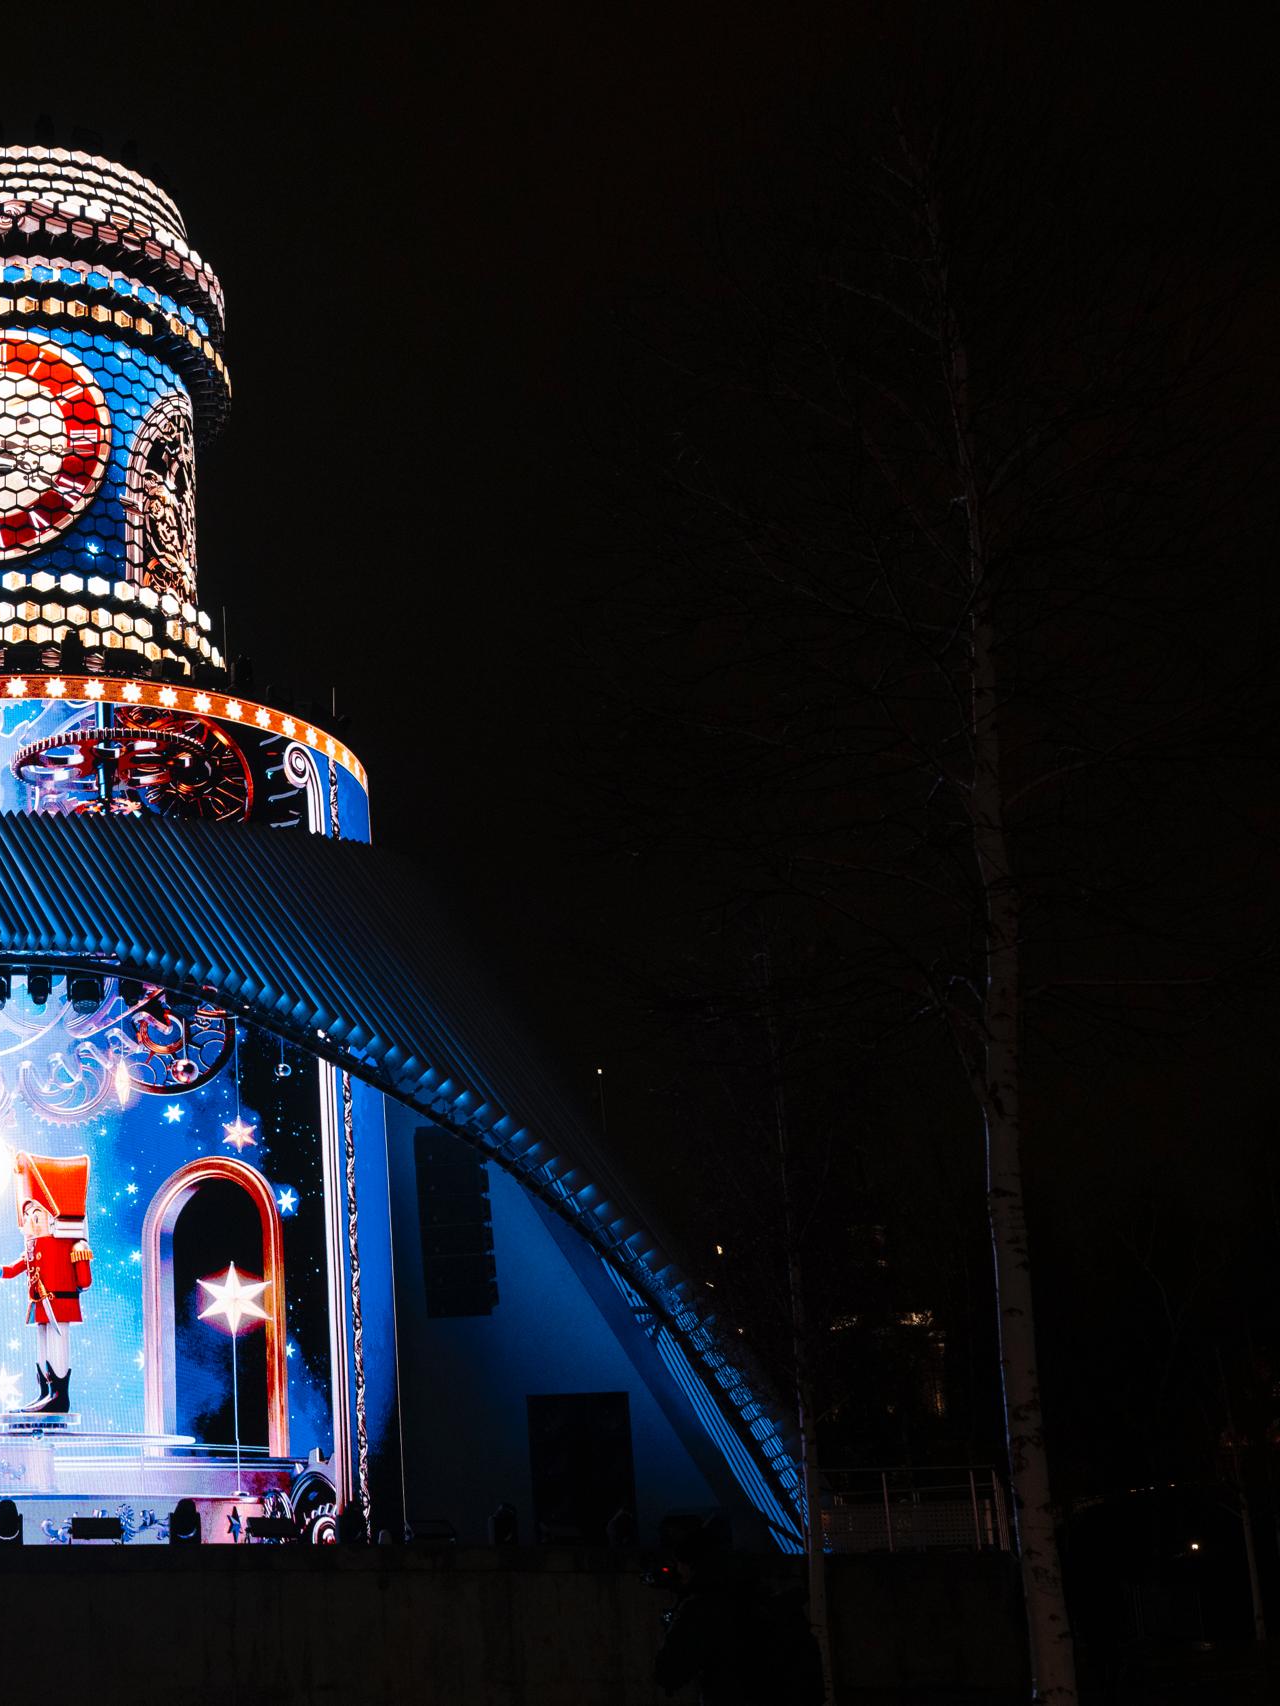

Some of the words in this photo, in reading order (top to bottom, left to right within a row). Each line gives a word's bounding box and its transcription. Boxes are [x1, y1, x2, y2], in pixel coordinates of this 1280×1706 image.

[55, 380, 83, 406] II
[55, 477, 85, 504] IV
[29, 506, 51, 536] V
